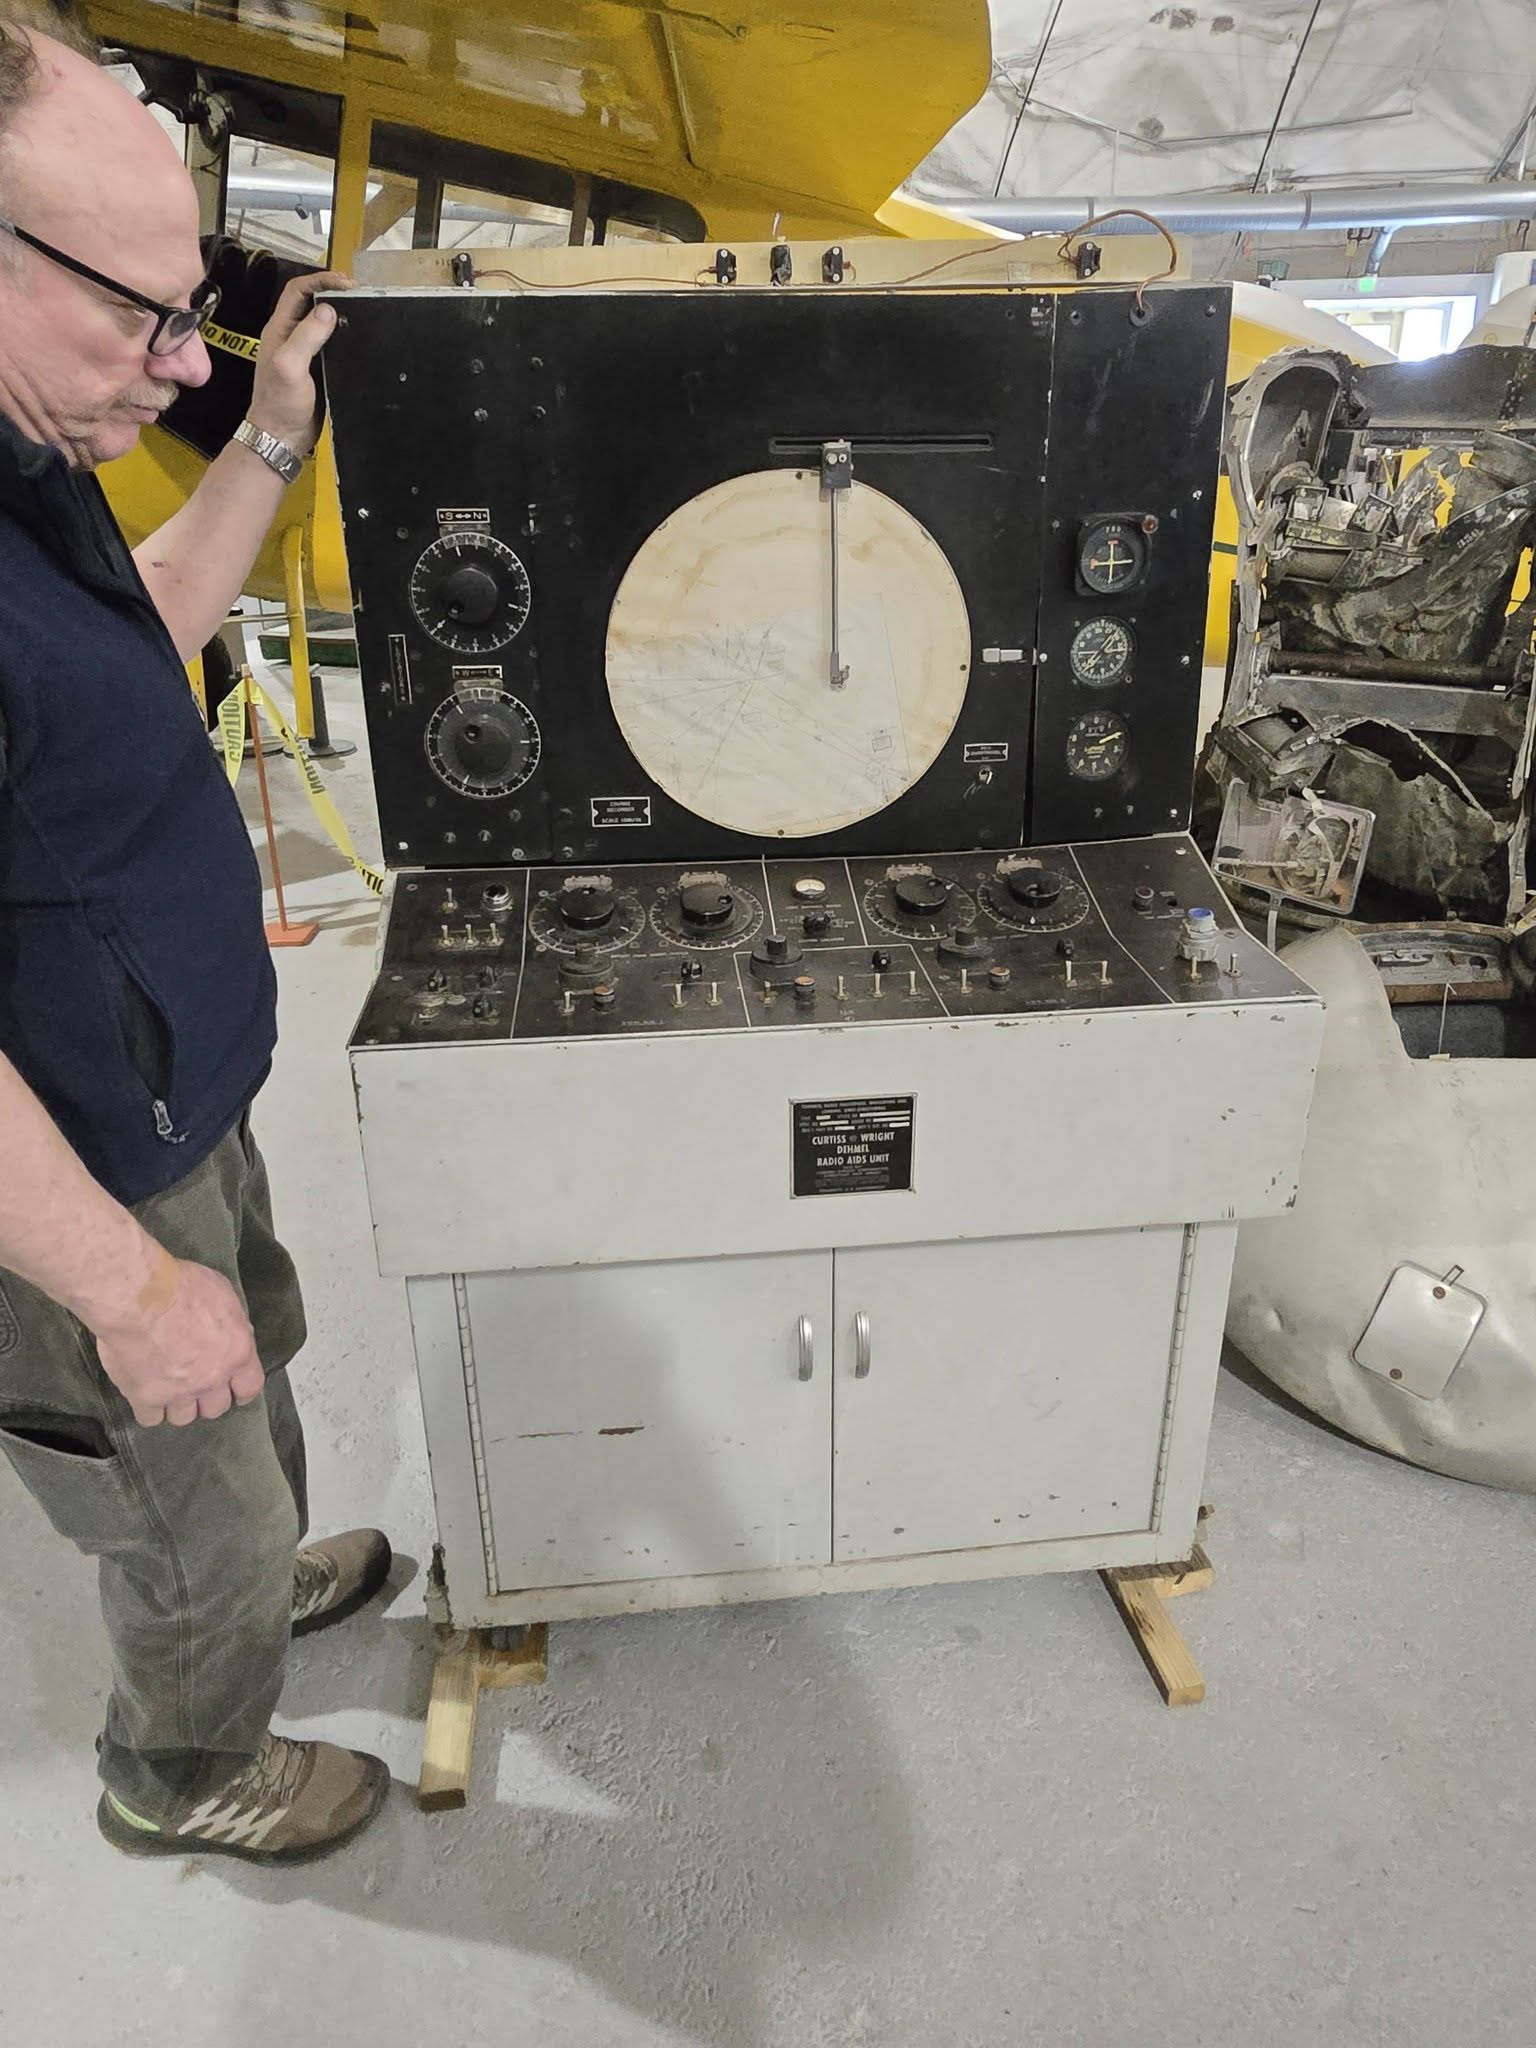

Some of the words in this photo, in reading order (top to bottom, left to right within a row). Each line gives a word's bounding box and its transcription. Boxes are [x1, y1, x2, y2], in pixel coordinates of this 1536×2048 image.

[218, 333, 249, 352] NOT
[445, 512, 453, 520] S
[473, 512, 482, 520] N
[812, 1134, 846, 1145] CURTISS
[861, 1132, 895, 1142] WRIGHT
[837, 1144, 870, 1154] DEHMEL
[817, 1157, 844, 1167] RADIO
[847, 1155, 867, 1165] AIDS
[870, 1153, 890, 1163] UNIT
